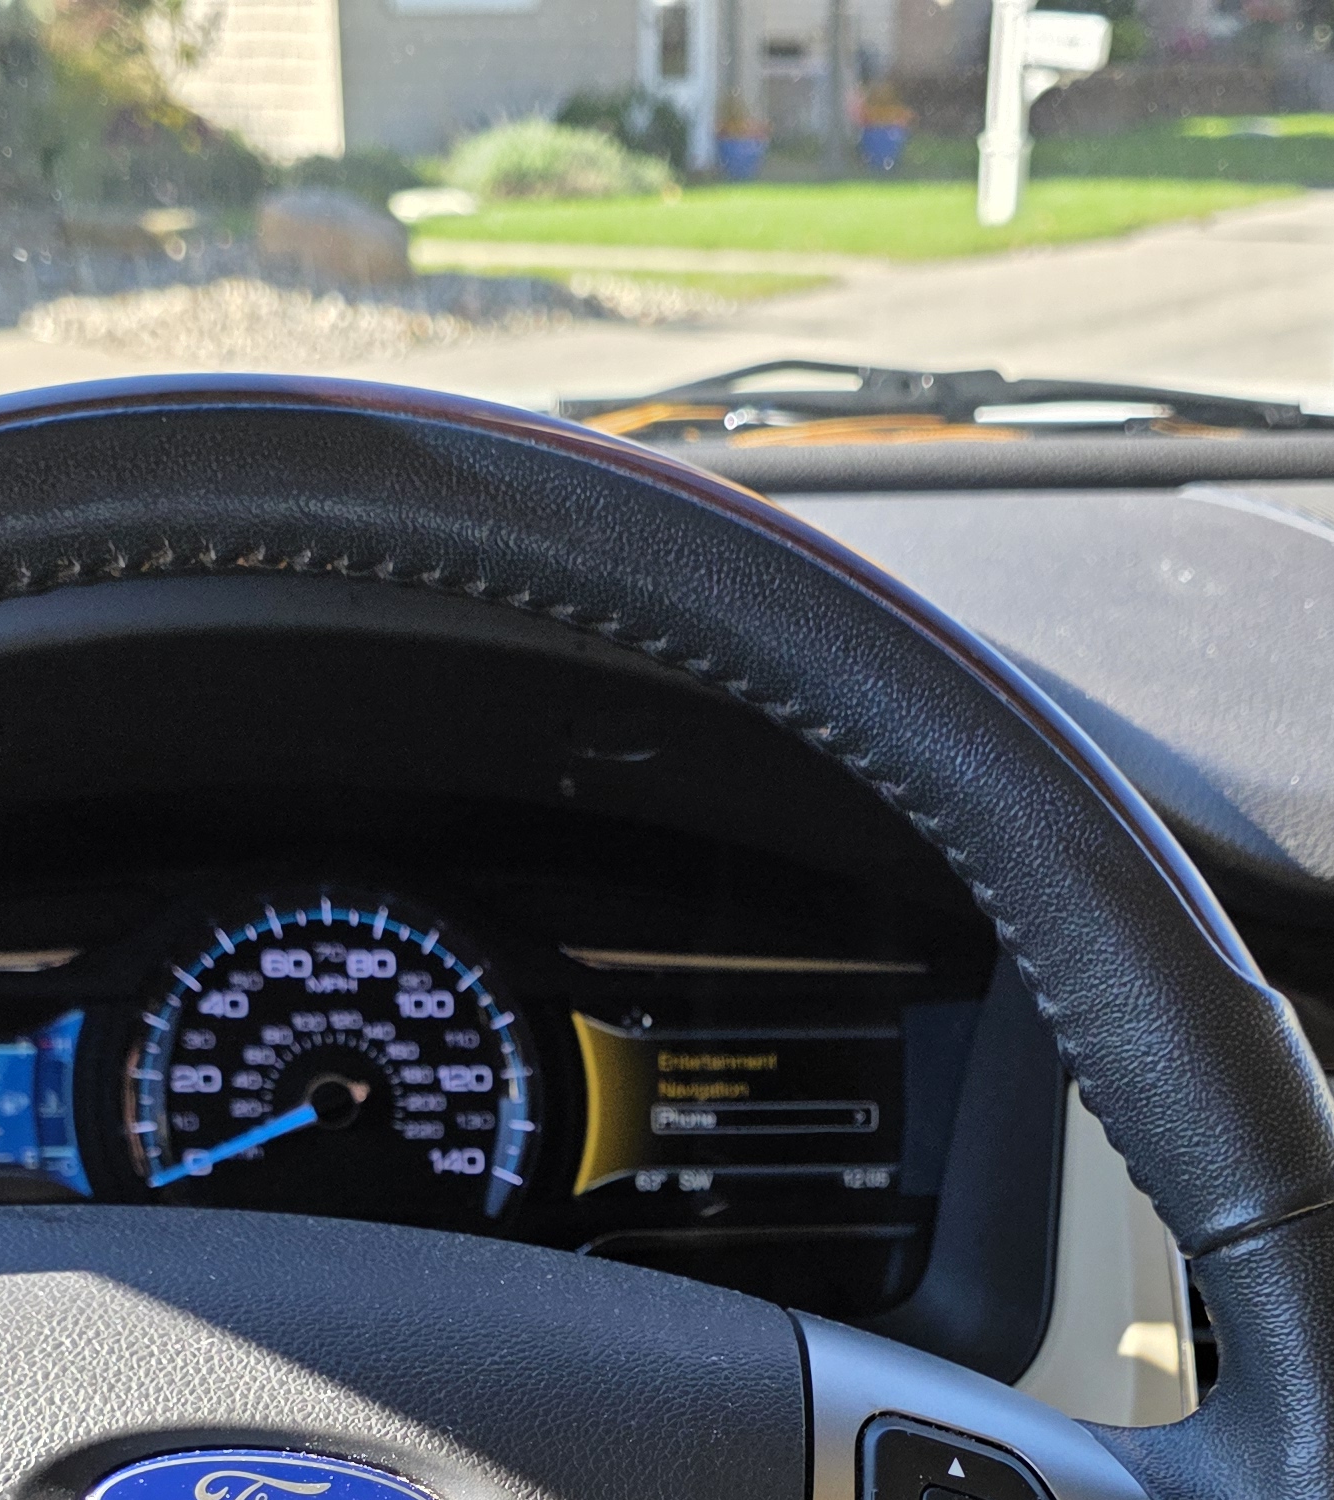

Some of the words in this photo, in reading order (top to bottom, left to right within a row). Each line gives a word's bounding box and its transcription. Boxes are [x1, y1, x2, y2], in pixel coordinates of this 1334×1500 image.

[260, 948, 313, 979] 60
[346, 948, 397, 979] 80
[197, 990, 250, 1018] 40
[395, 990, 455, 1018] 100
[170, 1064, 222, 1093] 20
[436, 1064, 494, 1092] 120
[658, 1081, 750, 1102] Navigation
[657, 1107, 717, 1129] Phone
[428, 1148, 486, 1175] 140
